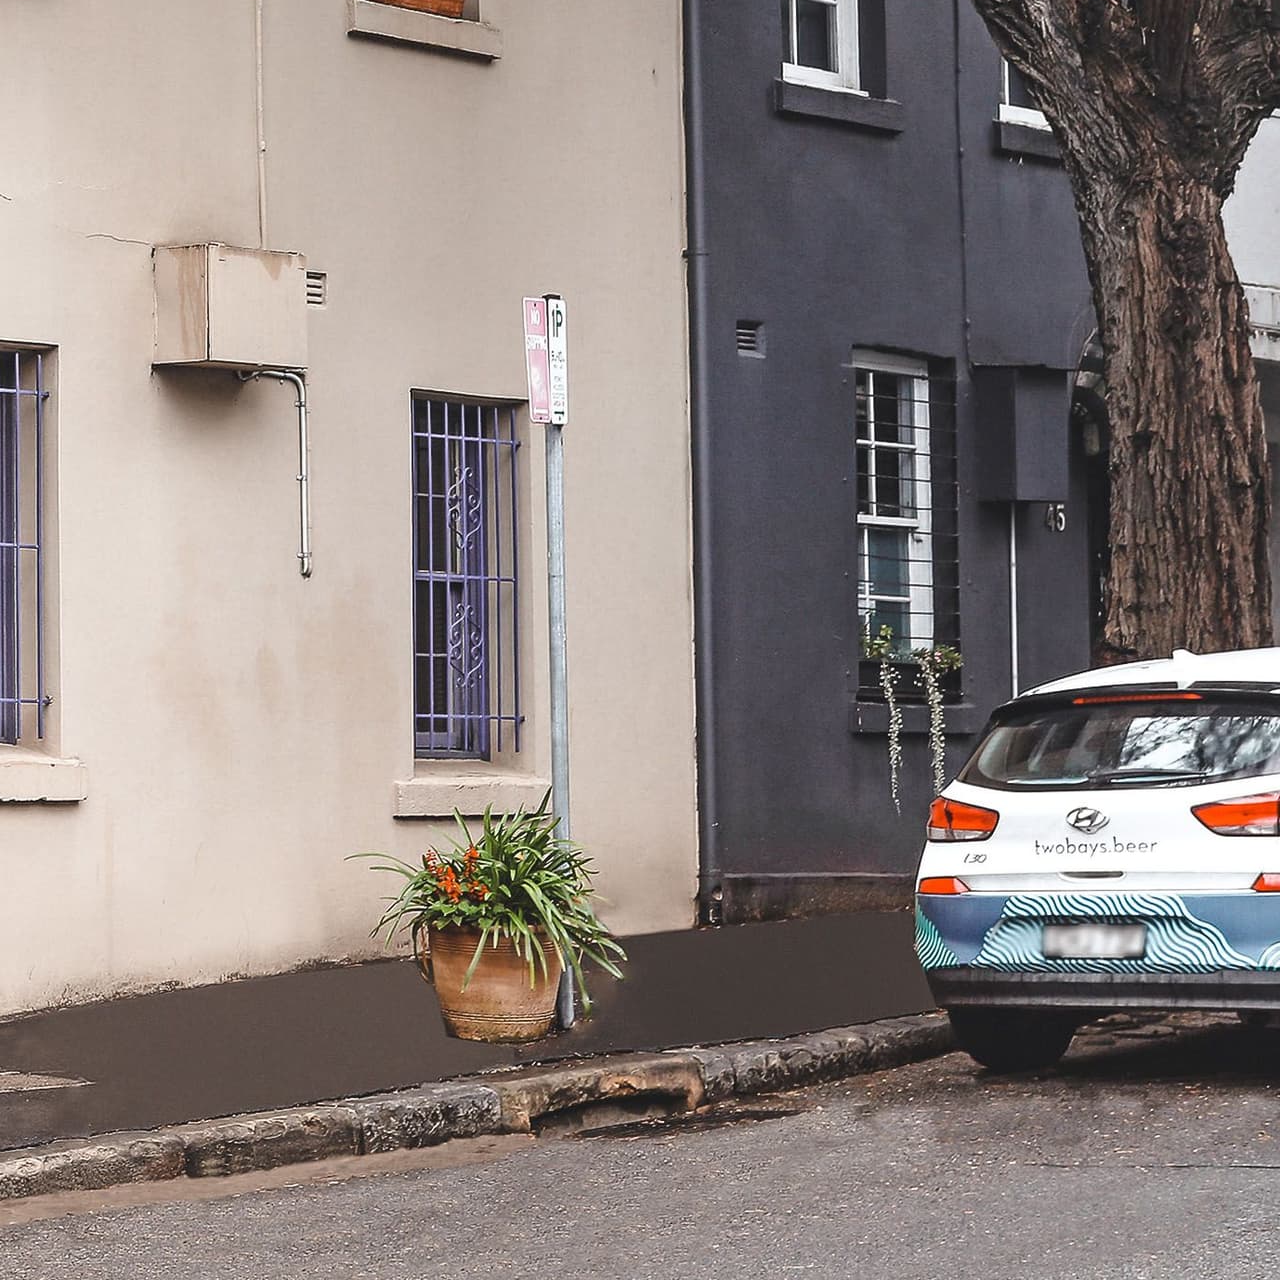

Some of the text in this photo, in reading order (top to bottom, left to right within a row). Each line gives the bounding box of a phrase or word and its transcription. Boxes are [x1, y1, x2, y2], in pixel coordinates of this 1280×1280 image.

[551, 309, 563, 337] 1P
[1047, 503, 1066, 532] 45
[1034, 836, 1159, 858] twobays.beer
